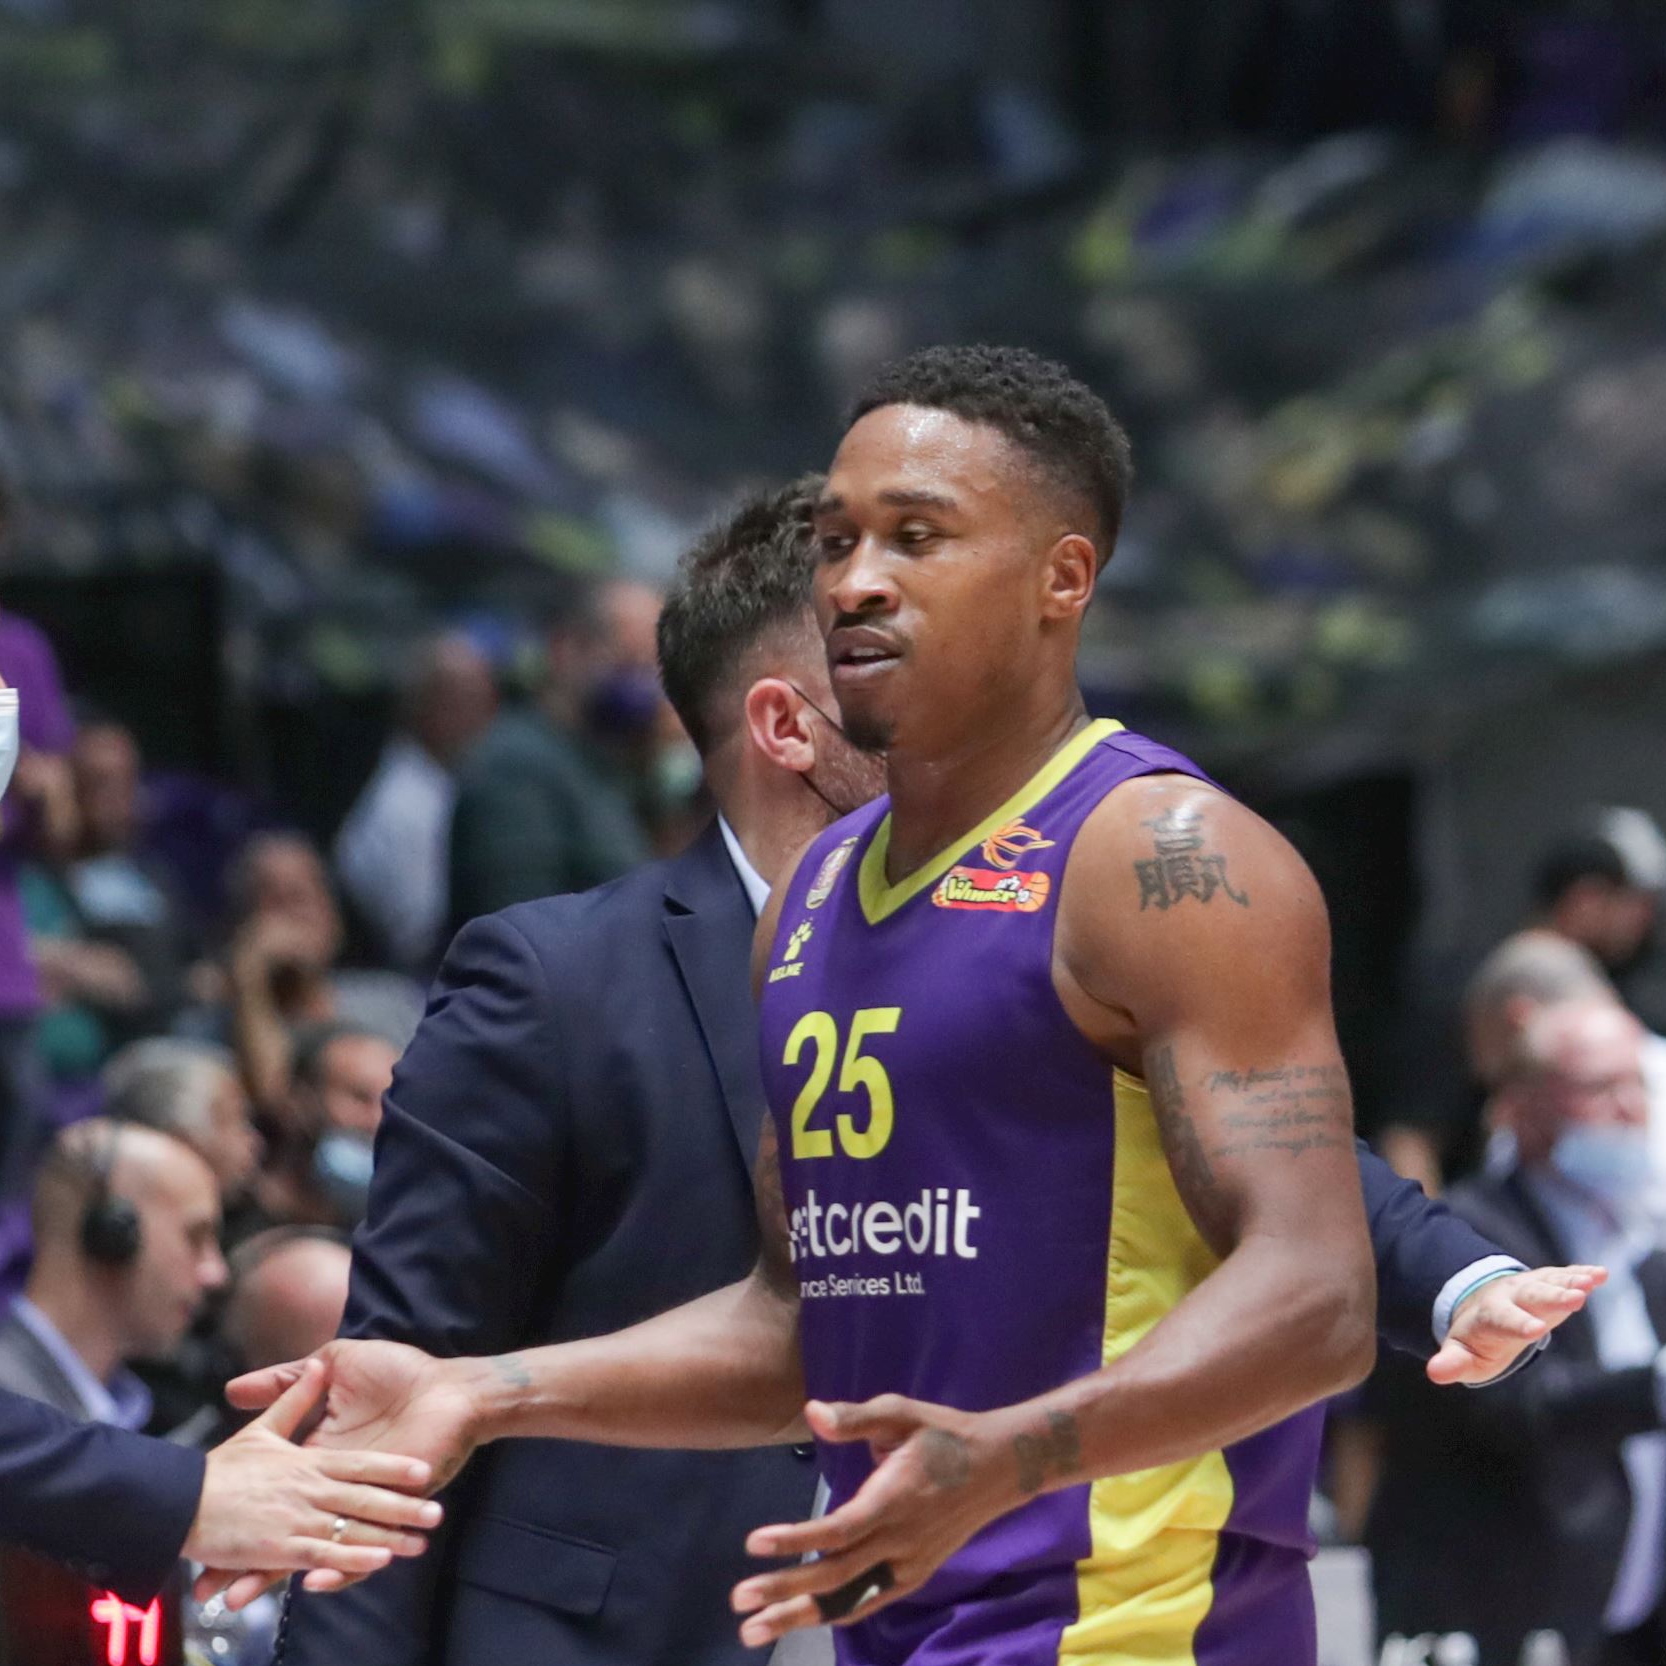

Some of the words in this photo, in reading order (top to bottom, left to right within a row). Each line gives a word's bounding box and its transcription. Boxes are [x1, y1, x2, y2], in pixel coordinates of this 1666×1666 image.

[944, 874, 1017, 903] Winner
[782, 1006, 903, 1160] 25
[895, 1271, 926, 1296] Ltd.
